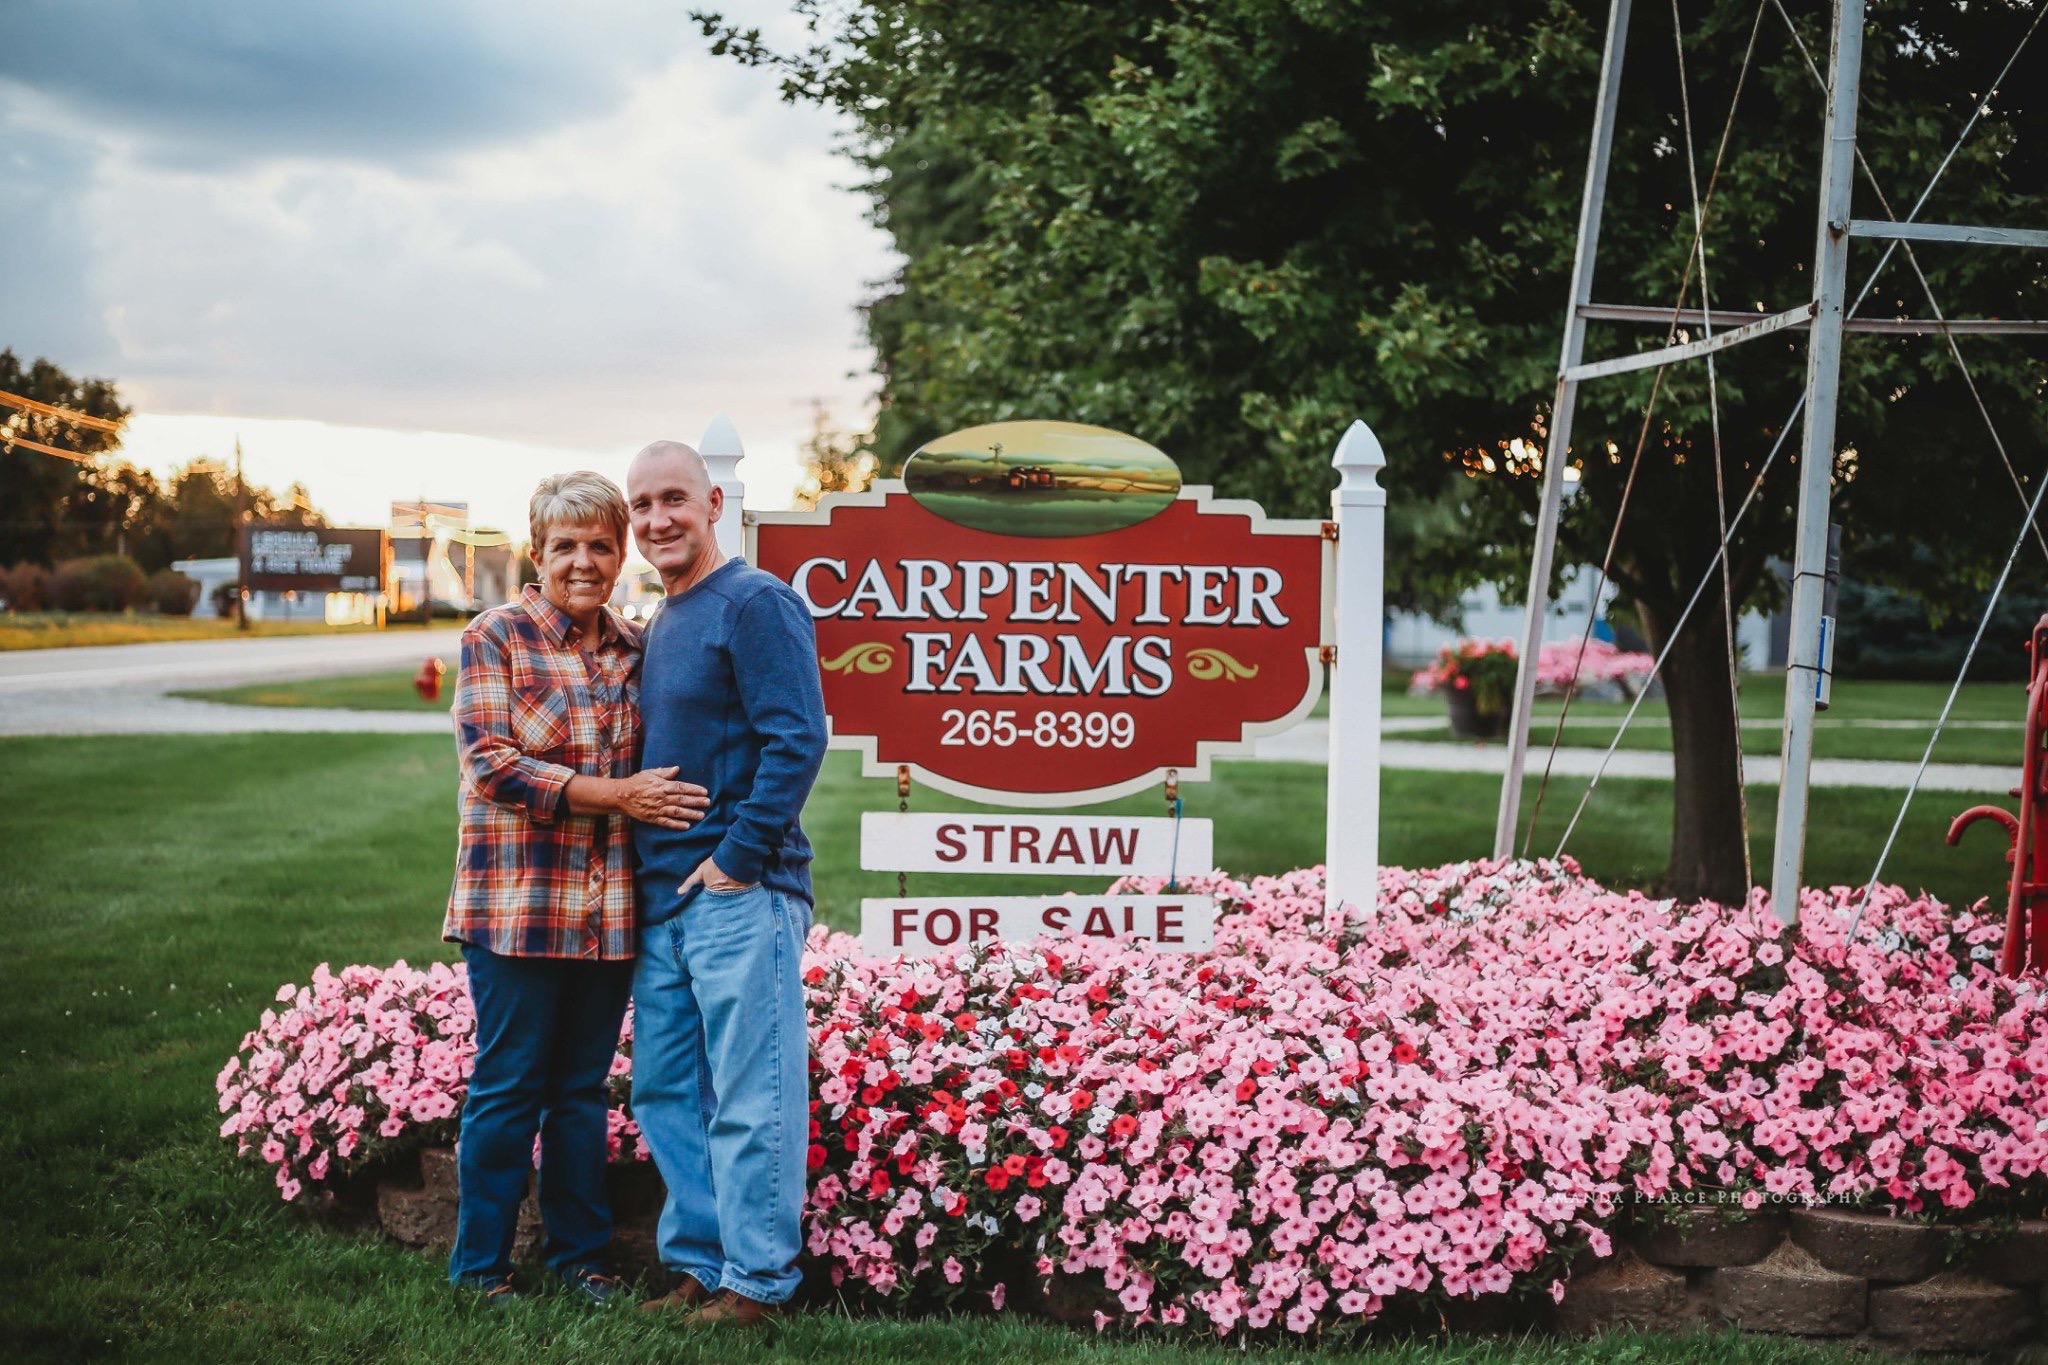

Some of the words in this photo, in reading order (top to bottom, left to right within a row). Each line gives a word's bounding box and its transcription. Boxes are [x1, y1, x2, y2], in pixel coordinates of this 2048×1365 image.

[791, 557, 1290, 628] CARPENTER
[902, 632, 1174, 698] FARMS
[940, 709, 1136, 749] 265-8399
[934, 823, 1140, 866] STRAW
[893, 907, 1000, 947] FOR
